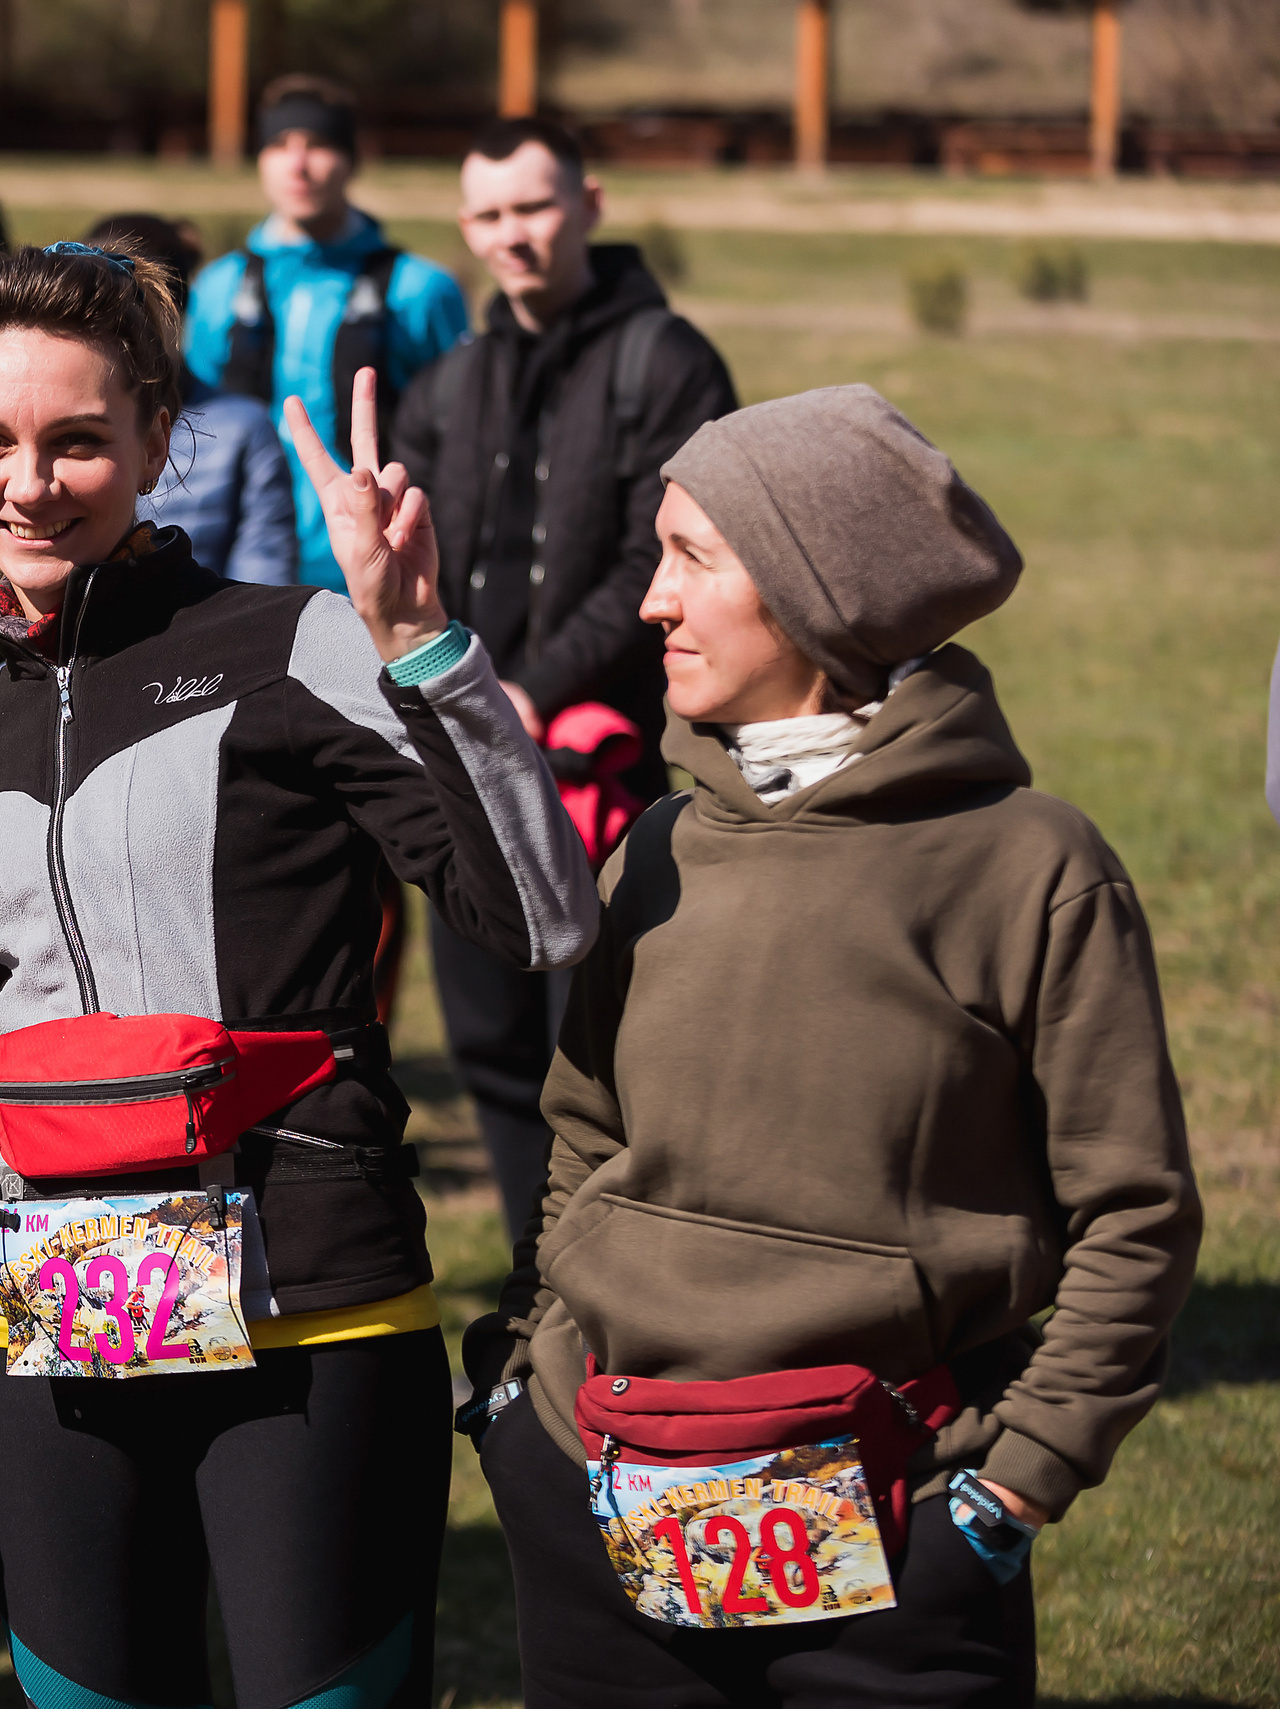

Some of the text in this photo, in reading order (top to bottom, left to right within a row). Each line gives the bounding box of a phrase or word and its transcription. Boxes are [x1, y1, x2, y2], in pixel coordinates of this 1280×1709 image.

[25, 1214, 49, 1233] KM
[9, 1215, 150, 1283] ESKI-KERMEN
[156, 1222, 219, 1276] TRAIL
[39, 1252, 191, 1365] 232
[189, 1356, 207, 1364] RUN
[627, 1474, 653, 1492] KM
[770, 1478, 844, 1522] TRAIL
[653, 1507, 820, 1615] 128
